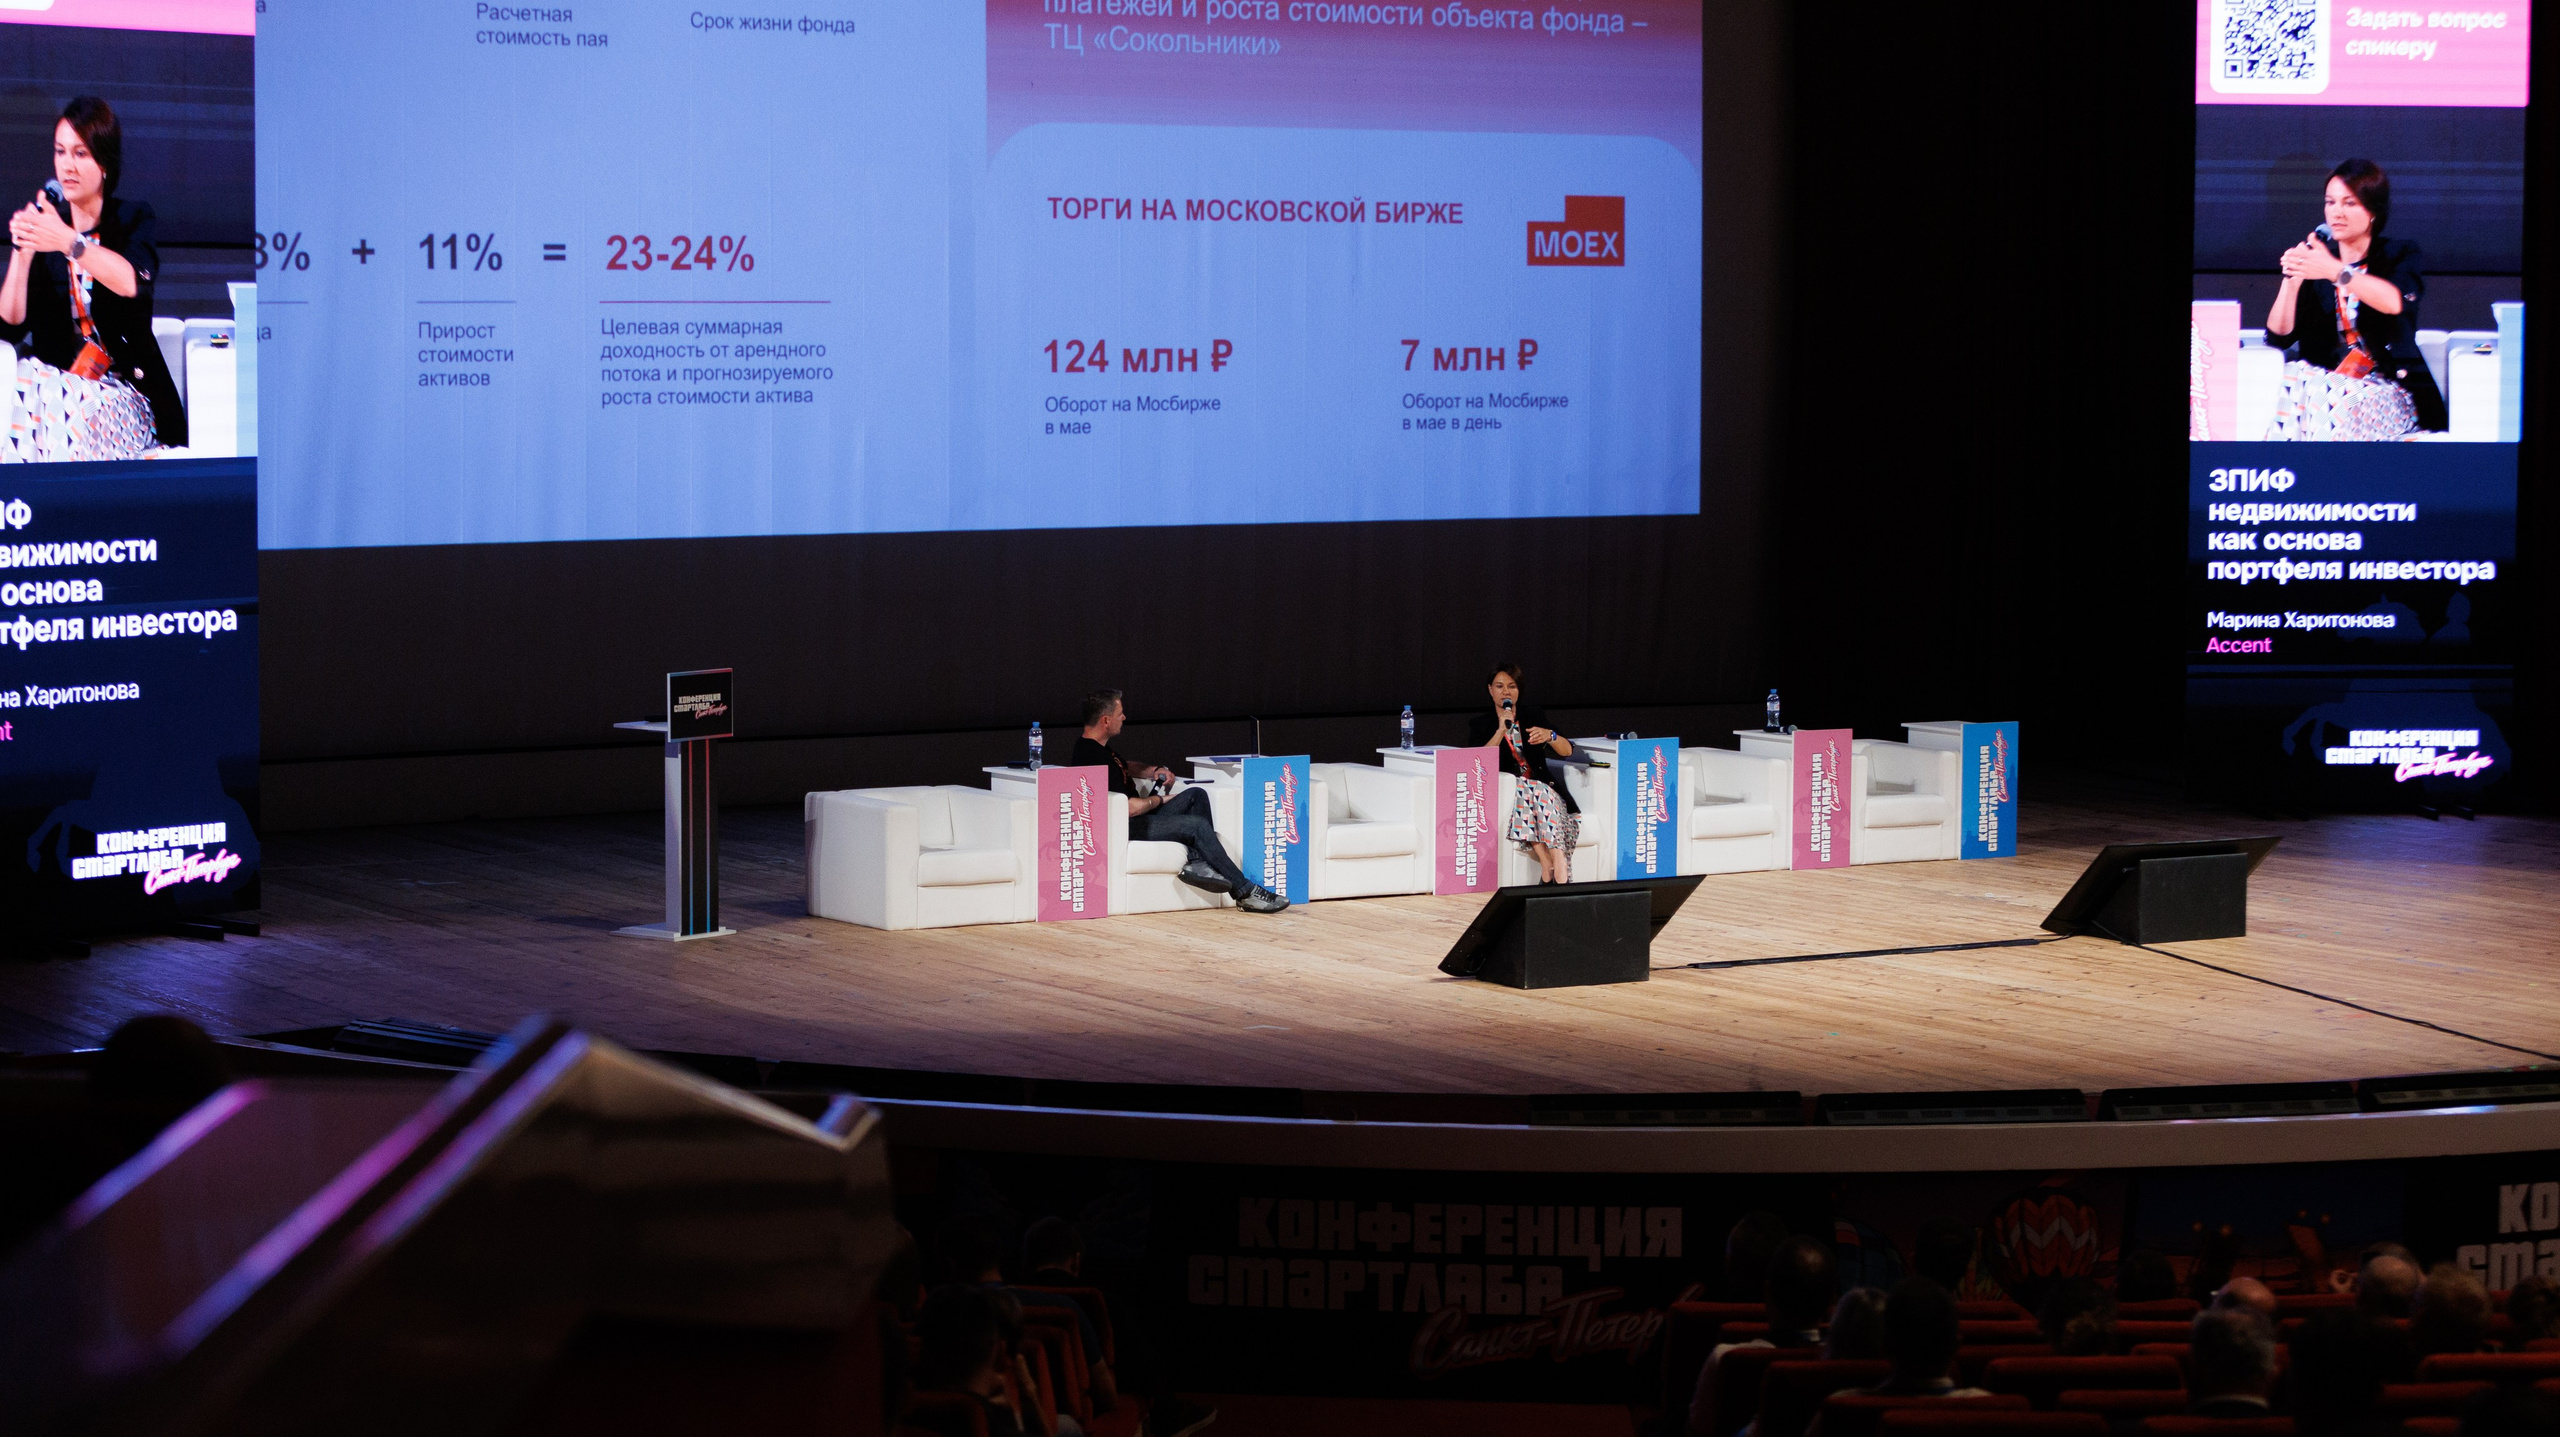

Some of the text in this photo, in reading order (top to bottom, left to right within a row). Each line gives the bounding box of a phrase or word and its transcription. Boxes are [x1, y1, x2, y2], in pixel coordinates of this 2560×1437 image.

[476, 3, 573, 22] Расчетная
[690, 11, 856, 35] Срок жизни фонда
[1182, 2, 1197, 17] и
[1207, 2, 1279, 24] роста
[1288, 4, 1423, 25] стоимости
[1431, 2, 1534, 29] объекта
[1542, 7, 1624, 36] фонда
[2346, 7, 2507, 33] Задать вопрос
[476, 29, 608, 47] стоимость пая
[1044, 23, 1281, 56] ТЦ «Сокольники»
[2345, 40, 2438, 61] спикеру
[1048, 196, 1463, 224] ТОРГИ НА МОСКОВСКОЙ БИРЖЕ
[419, 233, 503, 271] 11%
[606, 234, 755, 272] 23-24%
[1534, 230, 1619, 258] MOEX
[418, 321, 496, 342] Прирост
[601, 319, 783, 338] Целевая суммарная
[418, 349, 514, 363] стоимости
[600, 344, 826, 360] доходность от арендного
[1044, 339, 1109, 373] 124
[1122, 348, 1198, 373] млн
[1401, 339, 1420, 371] 7
[1433, 347, 1505, 371] млн
[418, 373, 491, 386] активов
[601, 366, 834, 384] потока и прогнозируемого
[602, 389, 813, 409] роста стоимости актива
[1045, 395, 1221, 415] Оборот на Мосбирже
[1402, 392, 1569, 411] Оборот на Мосбирже
[1045, 421, 1092, 434] в мае
[1402, 416, 1502, 432] в мае в день
[2208, 467, 2295, 492] ЗПИФ
[2208, 501, 2417, 525] недвижимости
[2208, 531, 2363, 551] как основа
[2207, 556, 2497, 586] портфеля инвестора
[1, 578, 104, 607] основа
[91, 608, 238, 639] инвестора
[2206, 610, 2396, 631] Марина Харитонова
[2205, 637, 2273, 653] Accent
[24, 682, 140, 709] Харитонова
[679, 693, 721, 704] КОНФЕРЕНЦИЯ
[2349, 729, 2480, 752] КОНФЕРЕНЦИЯ
[1826, 738, 1842, 811] Санкт-Петербург
[1993, 729, 2009, 801] Санкт-Петербург
[1472, 756, 1489, 833] Санкт-Петербург
[1651, 746, 1668, 822] Санкт-Петербург
[1978, 745, 1991, 841] КОНФЕРЕНЦИЯ
[1077, 776, 1096, 856] Санкт-Петербург
[1280, 763, 1299, 844] Санкт-Петербург
[1636, 762, 1649, 863] КОНФЕРЕНЦИЯ
[1811, 753, 1824, 852] КОНФЕРЕНЦИЯ
[1264, 781, 1278, 887] КОНФЕРЕНЦИЯ
[1456, 772, 1469, 875] КОНФЕРЕНЦИЯ
[97, 822, 227, 855] КОНФЕРЕНЦИЯ
[1060, 792, 1074, 901] КОНФЕРЕНЦИЯ
[1238, 1197, 1683, 1272] КОНФЕРЕНЦИЯ
[1410, 1284, 1706, 1380] Санкт-Петер
